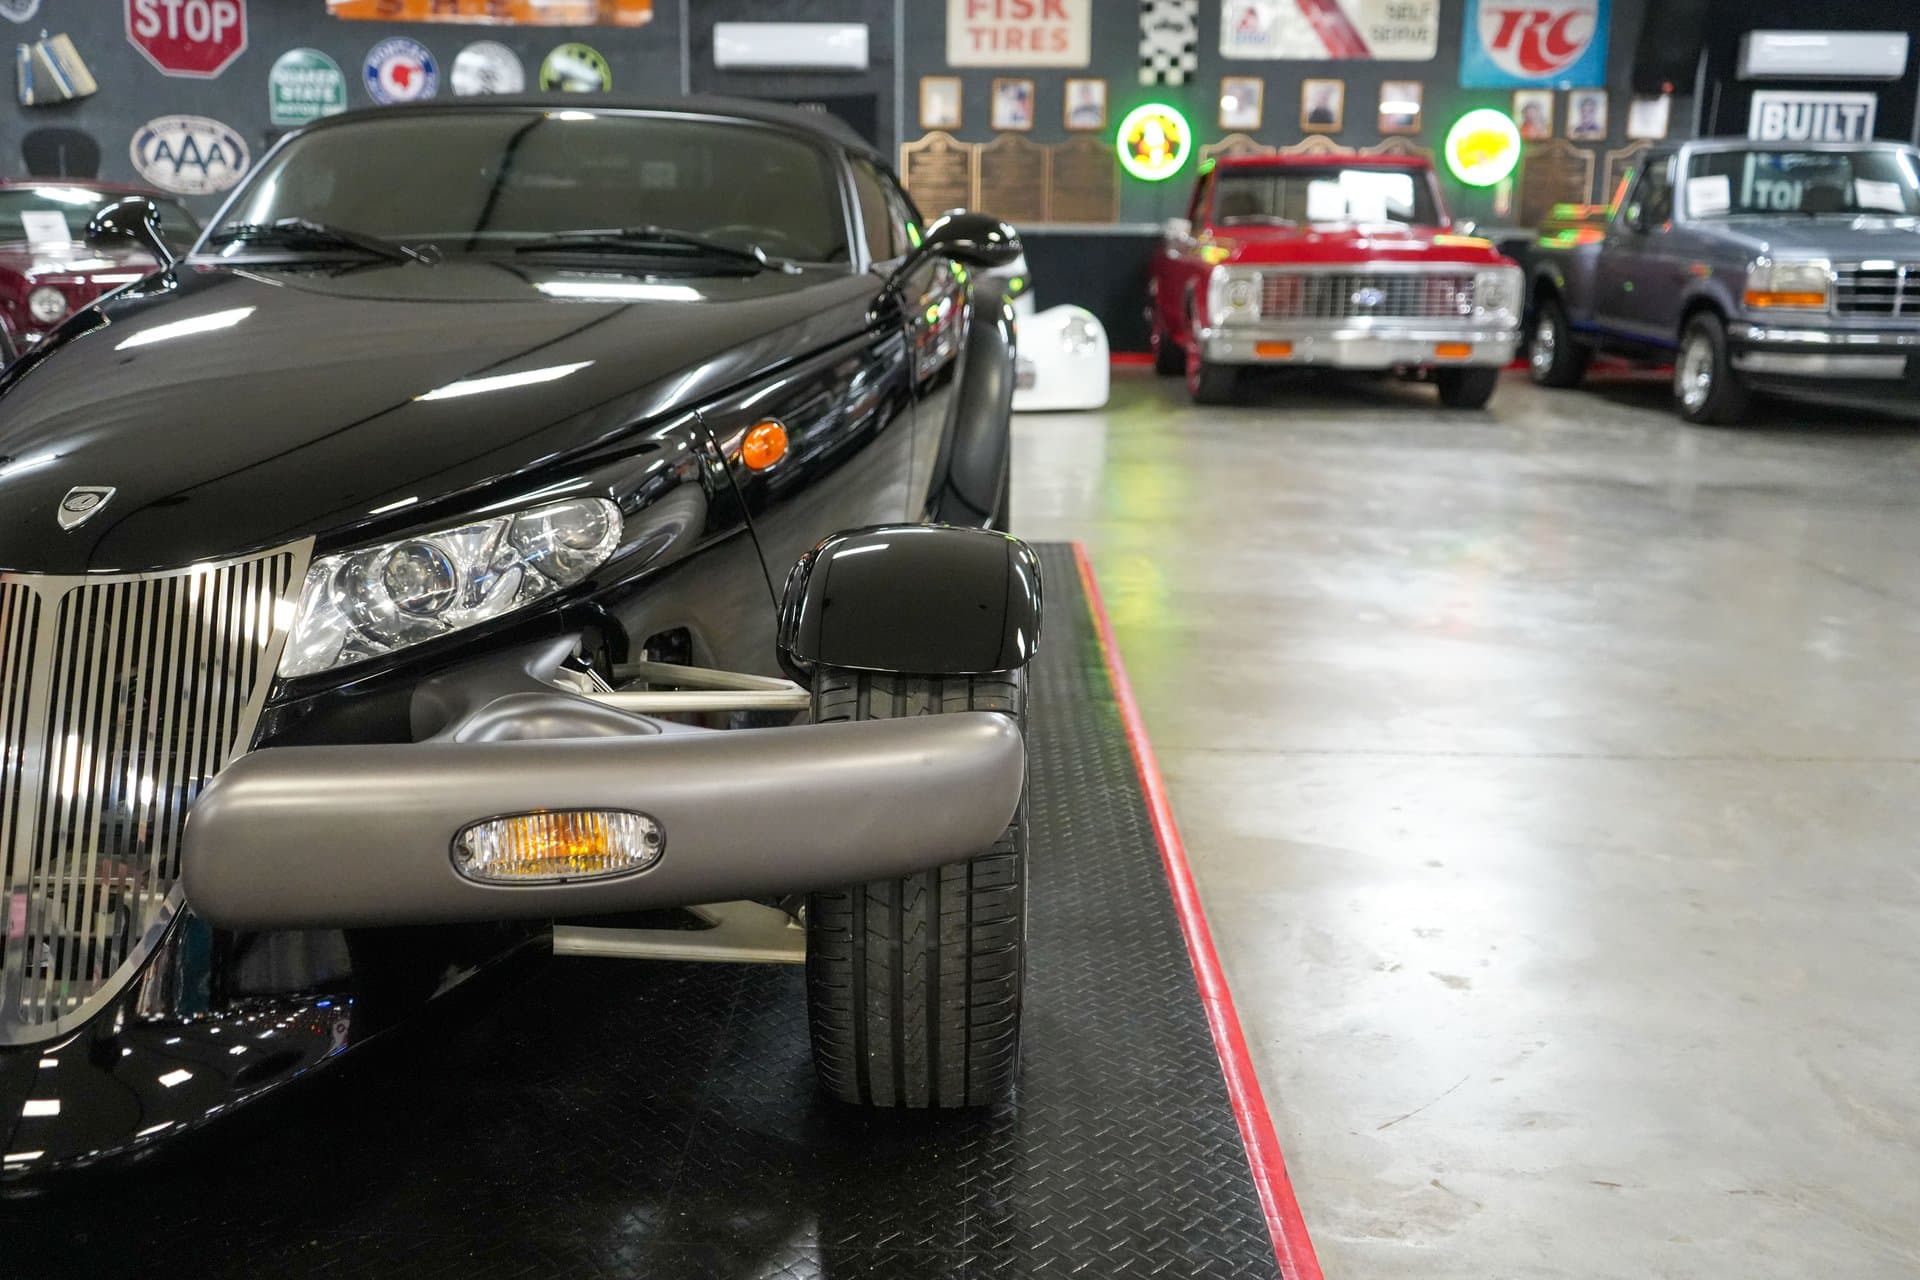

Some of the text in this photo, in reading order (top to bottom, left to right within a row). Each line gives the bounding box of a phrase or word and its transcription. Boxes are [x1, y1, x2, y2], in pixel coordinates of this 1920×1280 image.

[134, 0, 238, 43] STOP
[965, 0, 1069, 20] FISK
[966, 26, 1070, 52] TIRES
[1488, 9, 1591, 75] RC
[280, 85, 337, 101] STATE
[1762, 103, 1864, 142] BUILT
[153, 134, 228, 175] AAA
